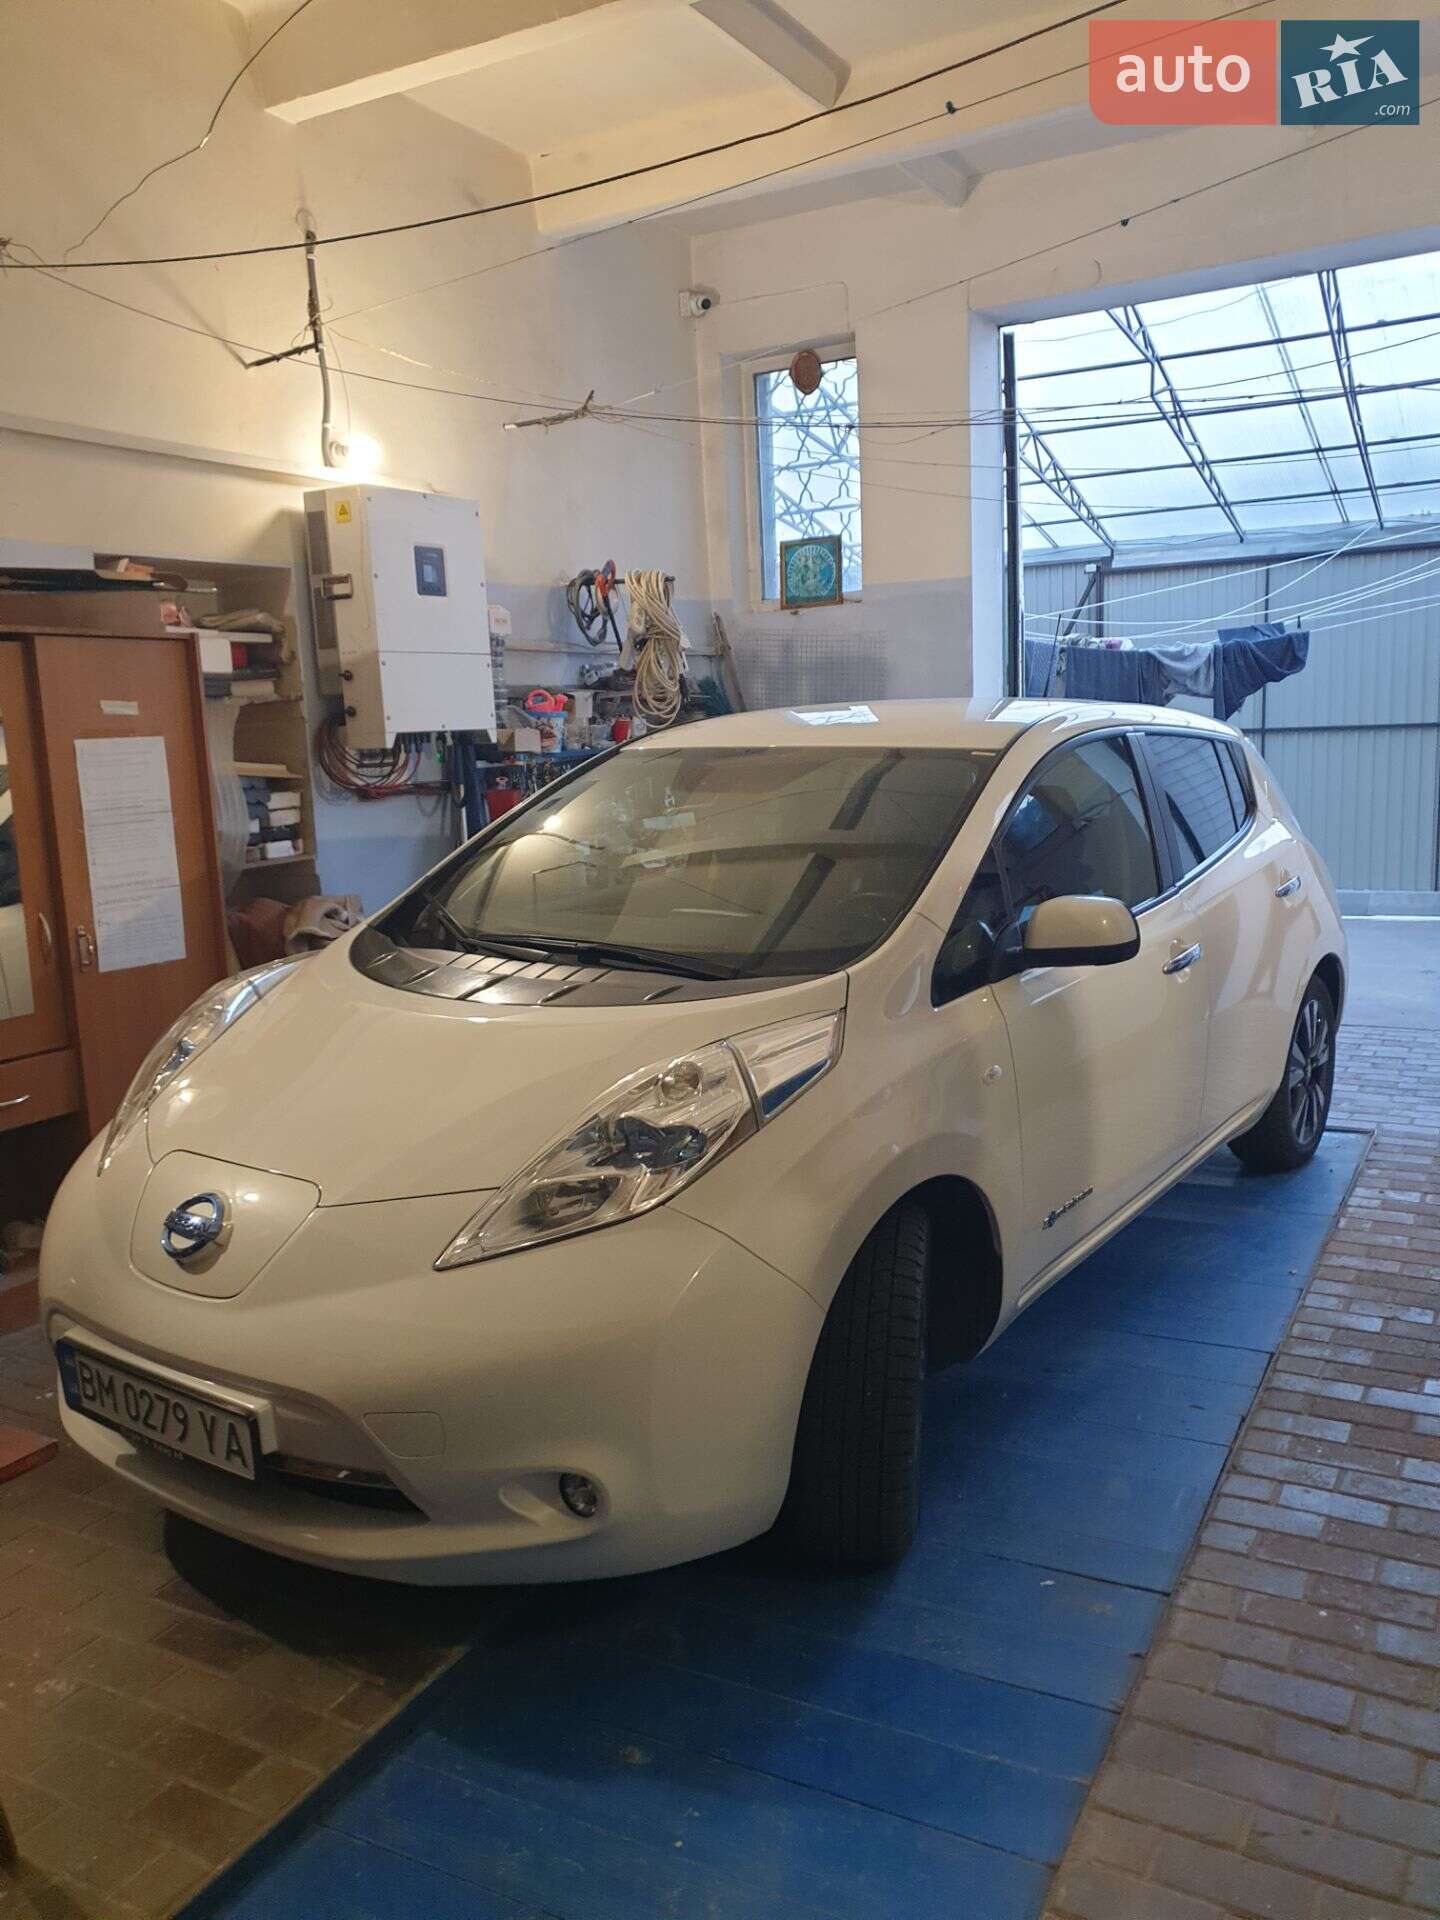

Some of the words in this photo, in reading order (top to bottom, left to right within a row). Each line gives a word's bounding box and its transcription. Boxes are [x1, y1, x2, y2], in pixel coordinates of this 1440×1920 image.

[79, 1360, 118, 1413] BM
[123, 1382, 189, 1443] 0279
[199, 1410, 249, 1469] YA
